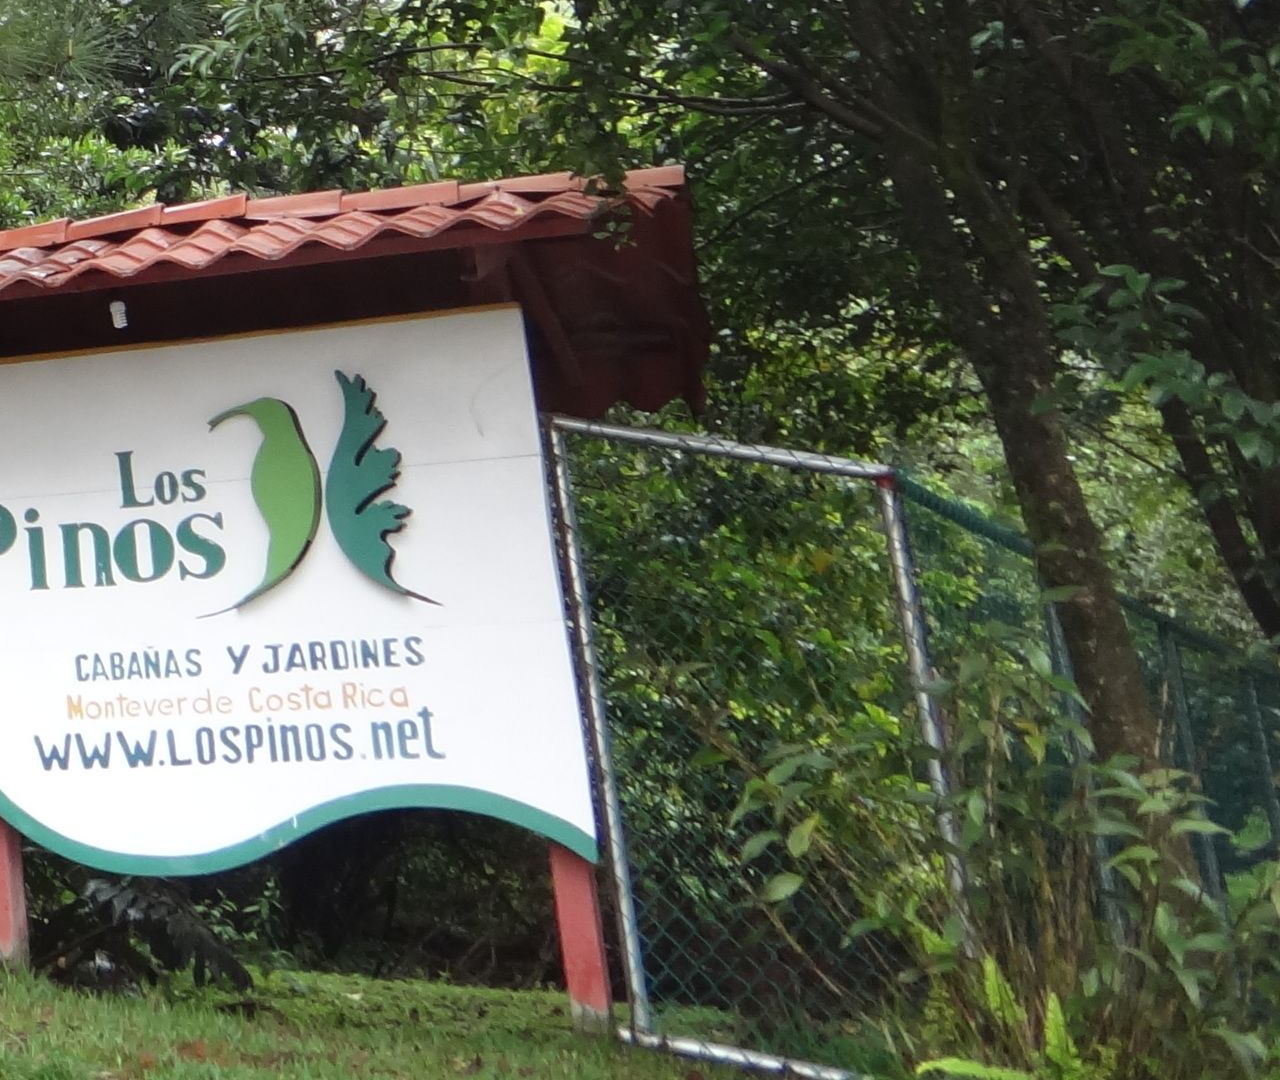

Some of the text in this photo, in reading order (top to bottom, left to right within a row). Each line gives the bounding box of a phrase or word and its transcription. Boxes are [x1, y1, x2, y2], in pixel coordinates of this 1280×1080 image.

[114, 450, 206, 508] Los
[74, 636, 425, 682] CABAÑAS Y JARDINES
[66, 681, 410, 720] Monteverde Costa Rica
